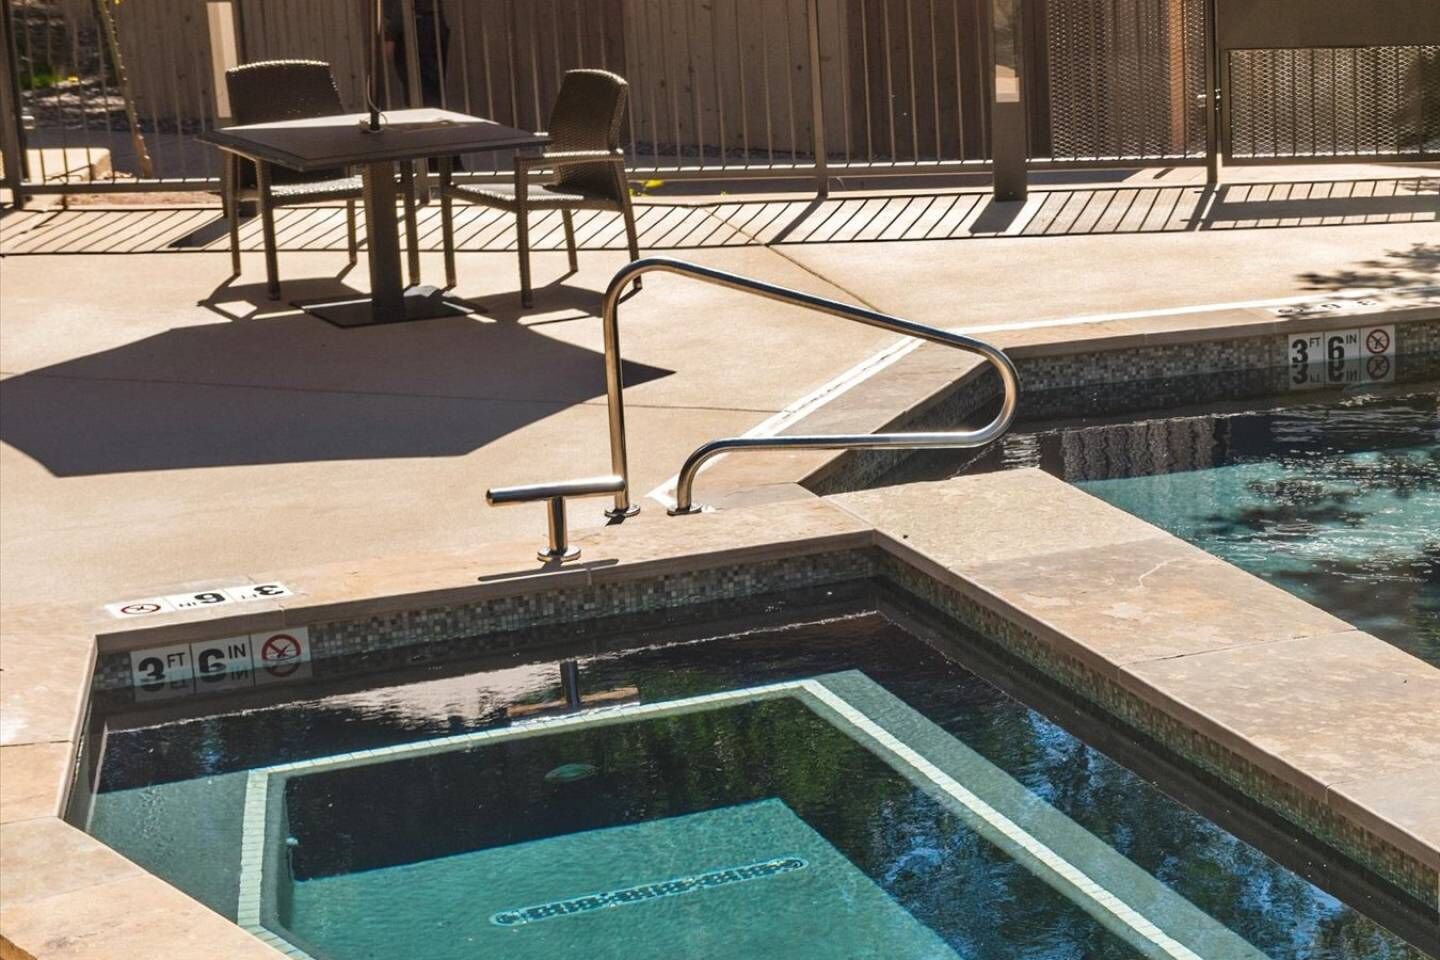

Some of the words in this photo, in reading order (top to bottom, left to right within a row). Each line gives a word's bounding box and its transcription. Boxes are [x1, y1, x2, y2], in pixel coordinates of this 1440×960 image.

[1291, 338, 1309, 363] 3
[1309, 337, 1321, 347] FT
[1327, 335, 1345, 360] 6
[1345, 333, 1358, 344] IN
[194, 592, 226, 604] 6
[253, 584, 285, 596] 3
[137, 656, 166, 682] 3
[167, 651, 186, 668] FT
[197, 648, 227, 674] 6
[228, 643, 247, 659] IN
